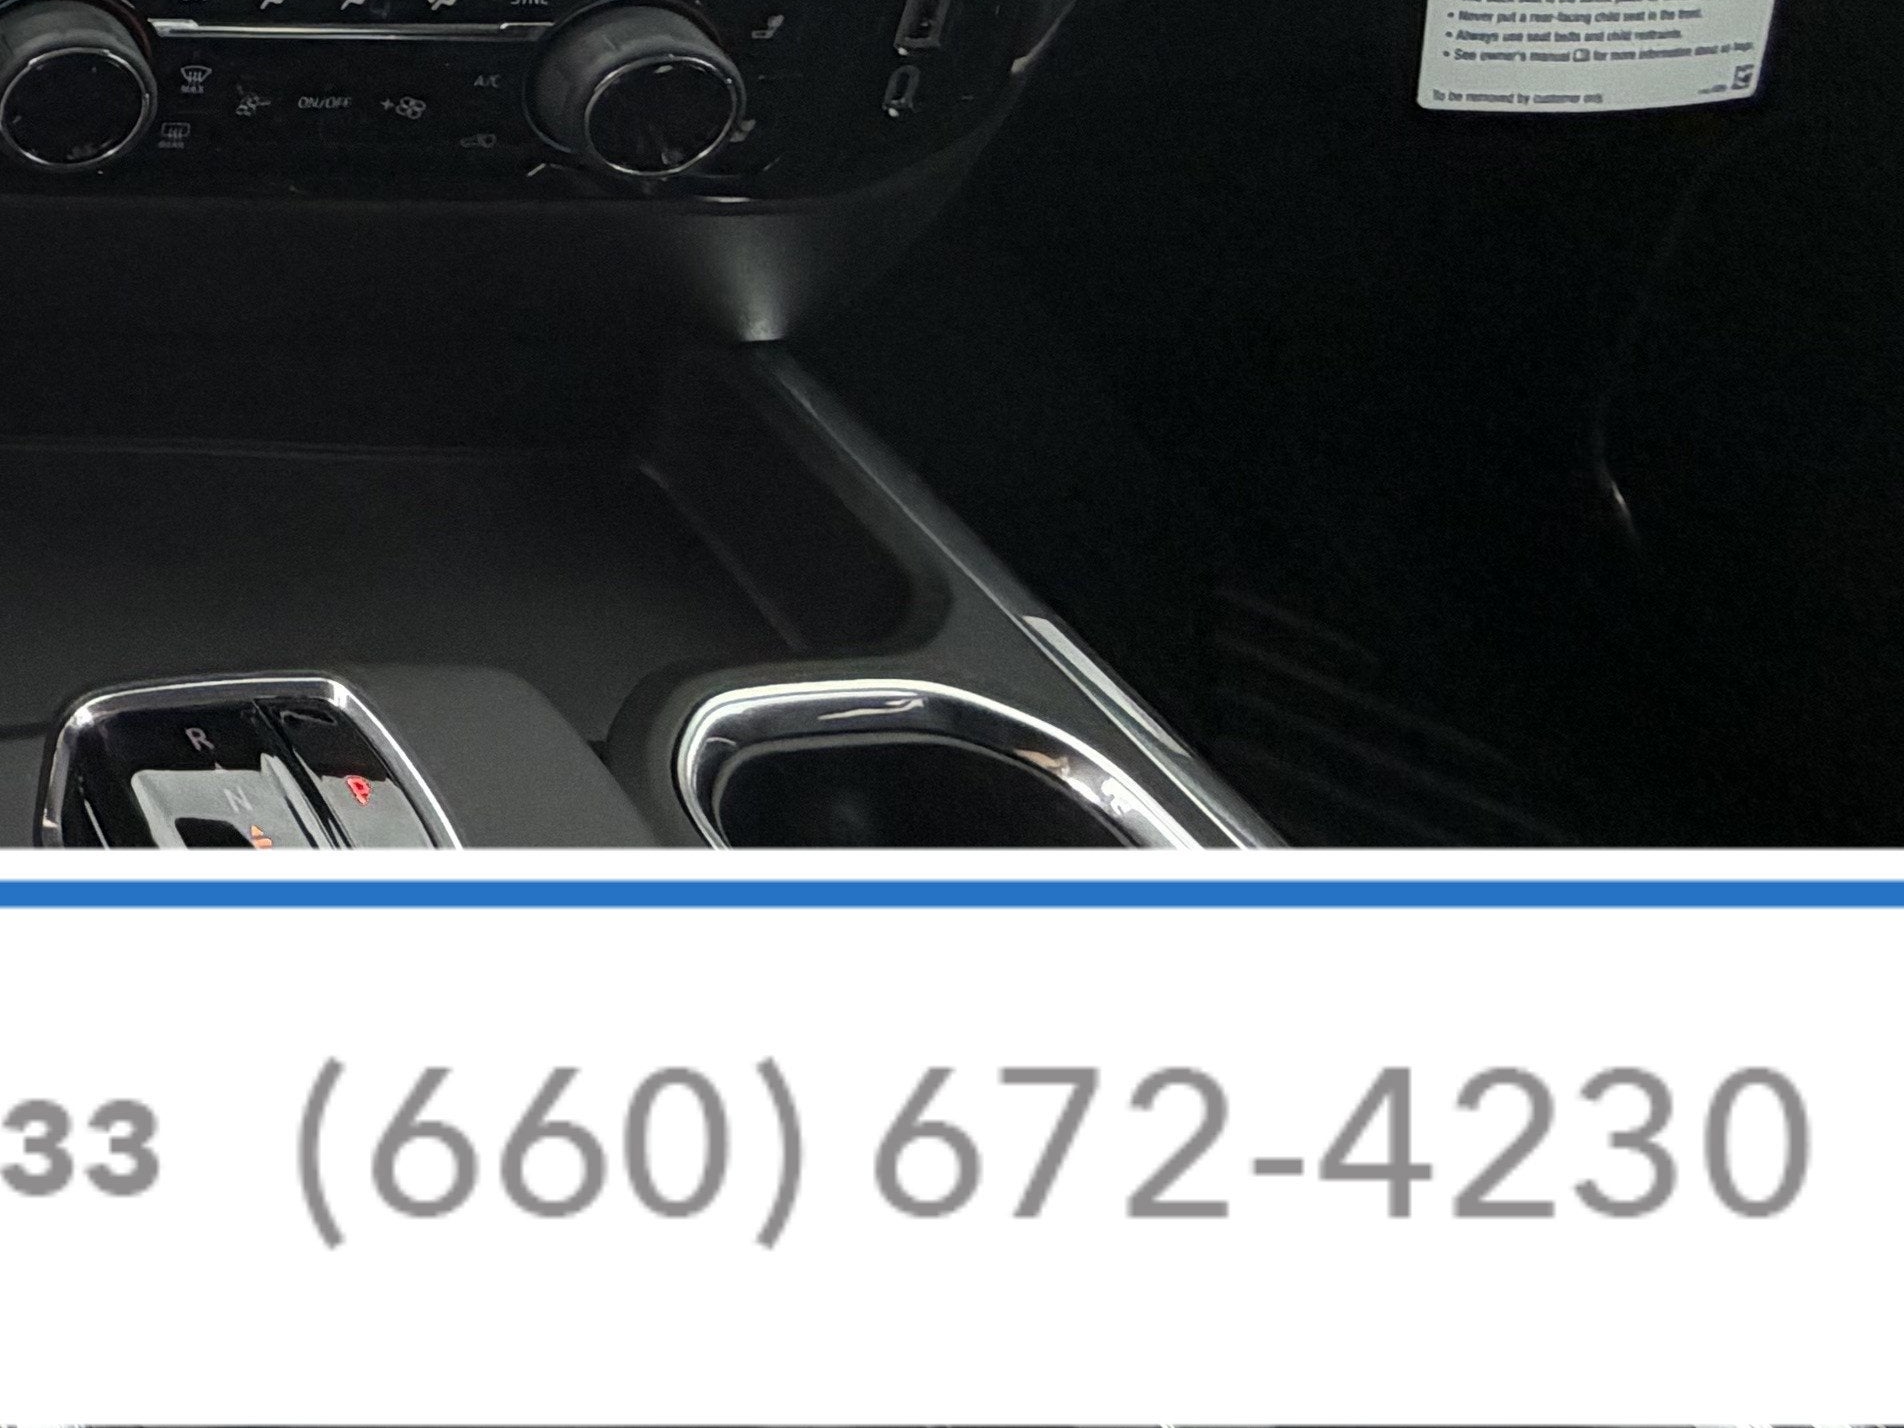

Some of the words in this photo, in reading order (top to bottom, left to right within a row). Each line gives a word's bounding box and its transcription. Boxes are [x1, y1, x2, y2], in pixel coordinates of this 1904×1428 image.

[297, 96, 352, 111] ON/OFF
[185, 727, 214, 751] R
[223, 788, 254, 814] N
